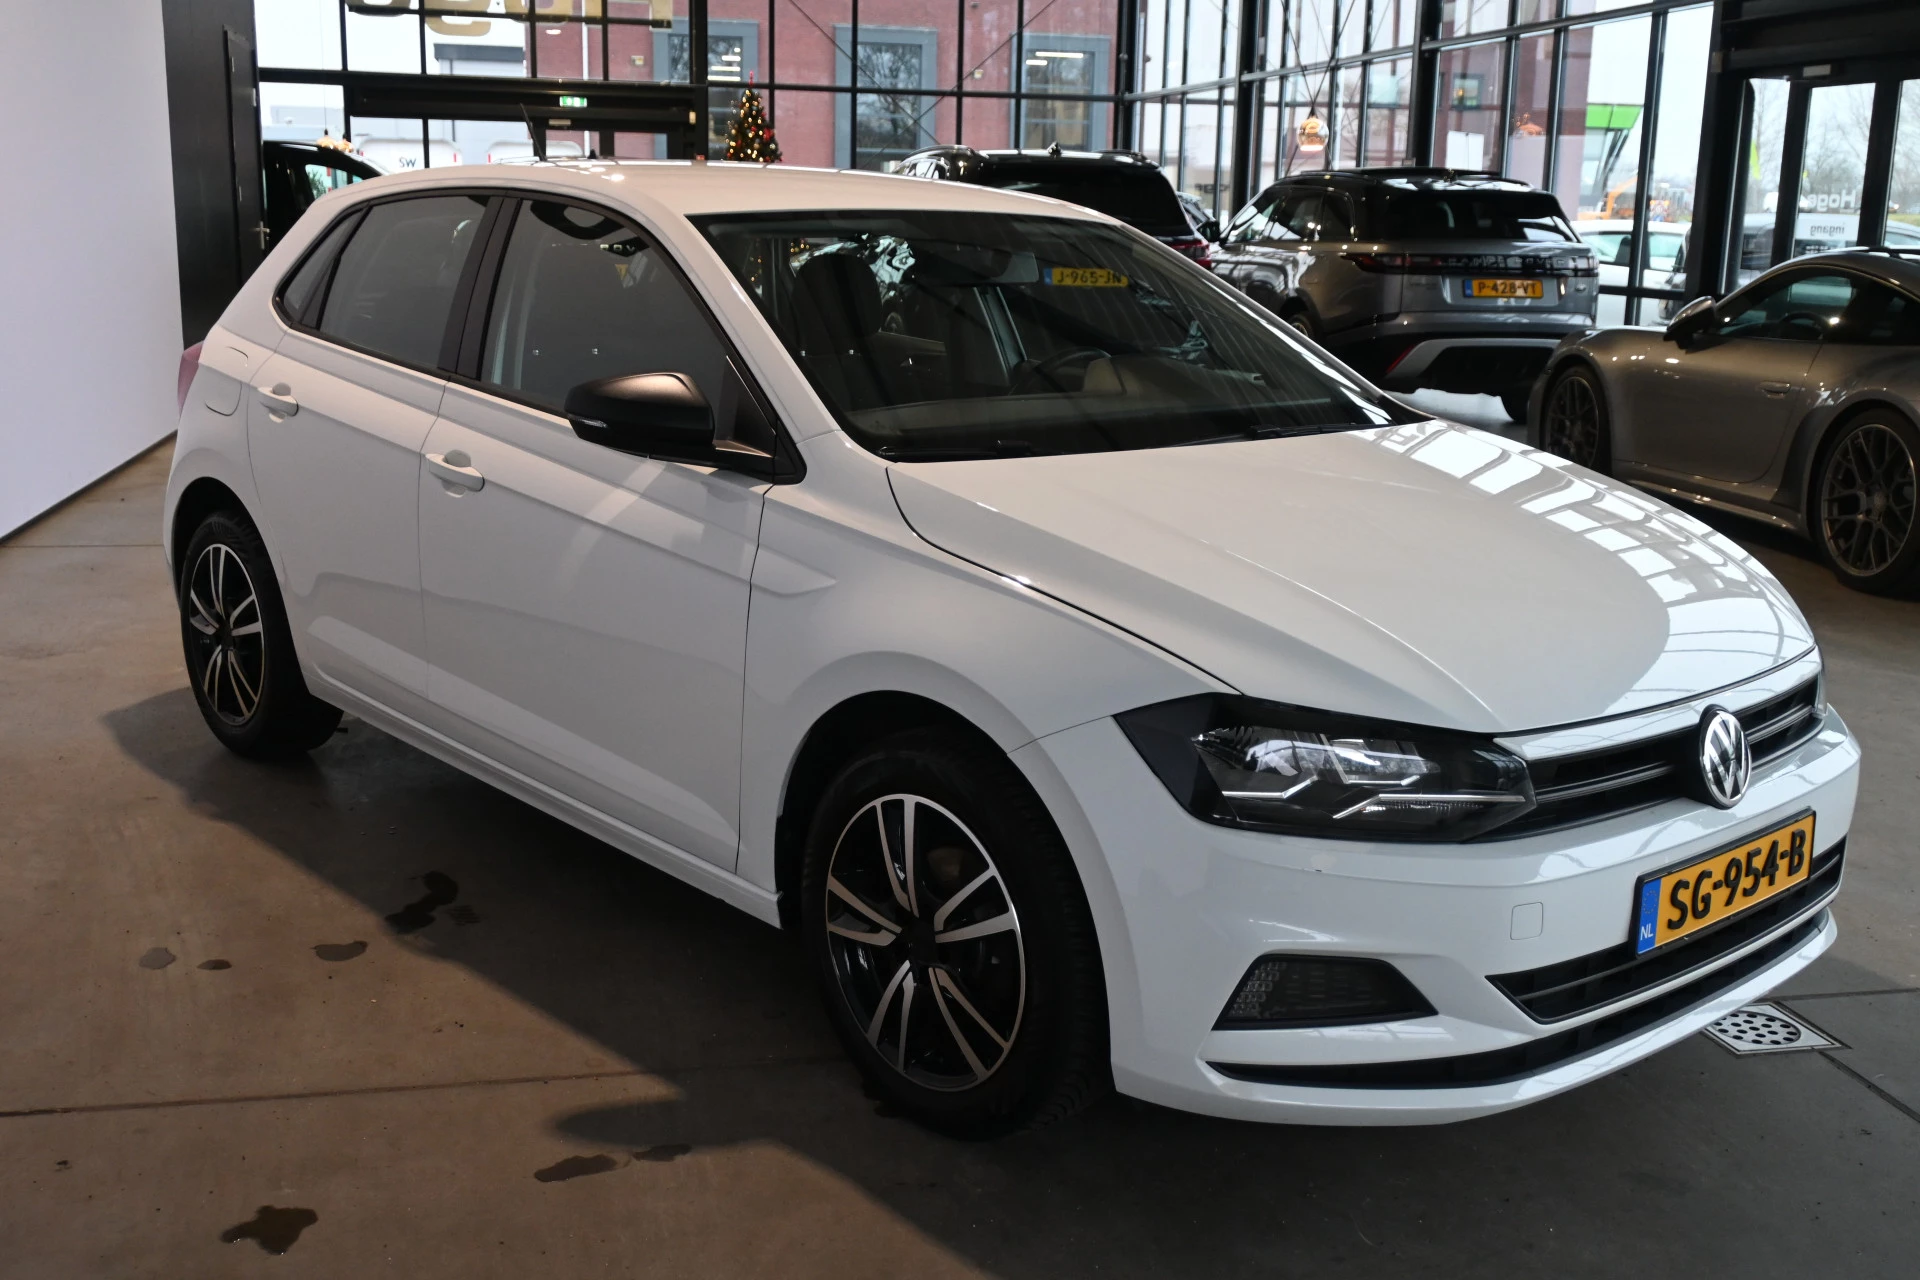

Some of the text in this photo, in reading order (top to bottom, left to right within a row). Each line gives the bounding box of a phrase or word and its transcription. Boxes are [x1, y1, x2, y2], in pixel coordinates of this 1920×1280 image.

[1478, 282, 1538, 295] P-428-VT
[1667, 828, 1807, 930] SG-954-B
[1640, 923, 1654, 941] NL
